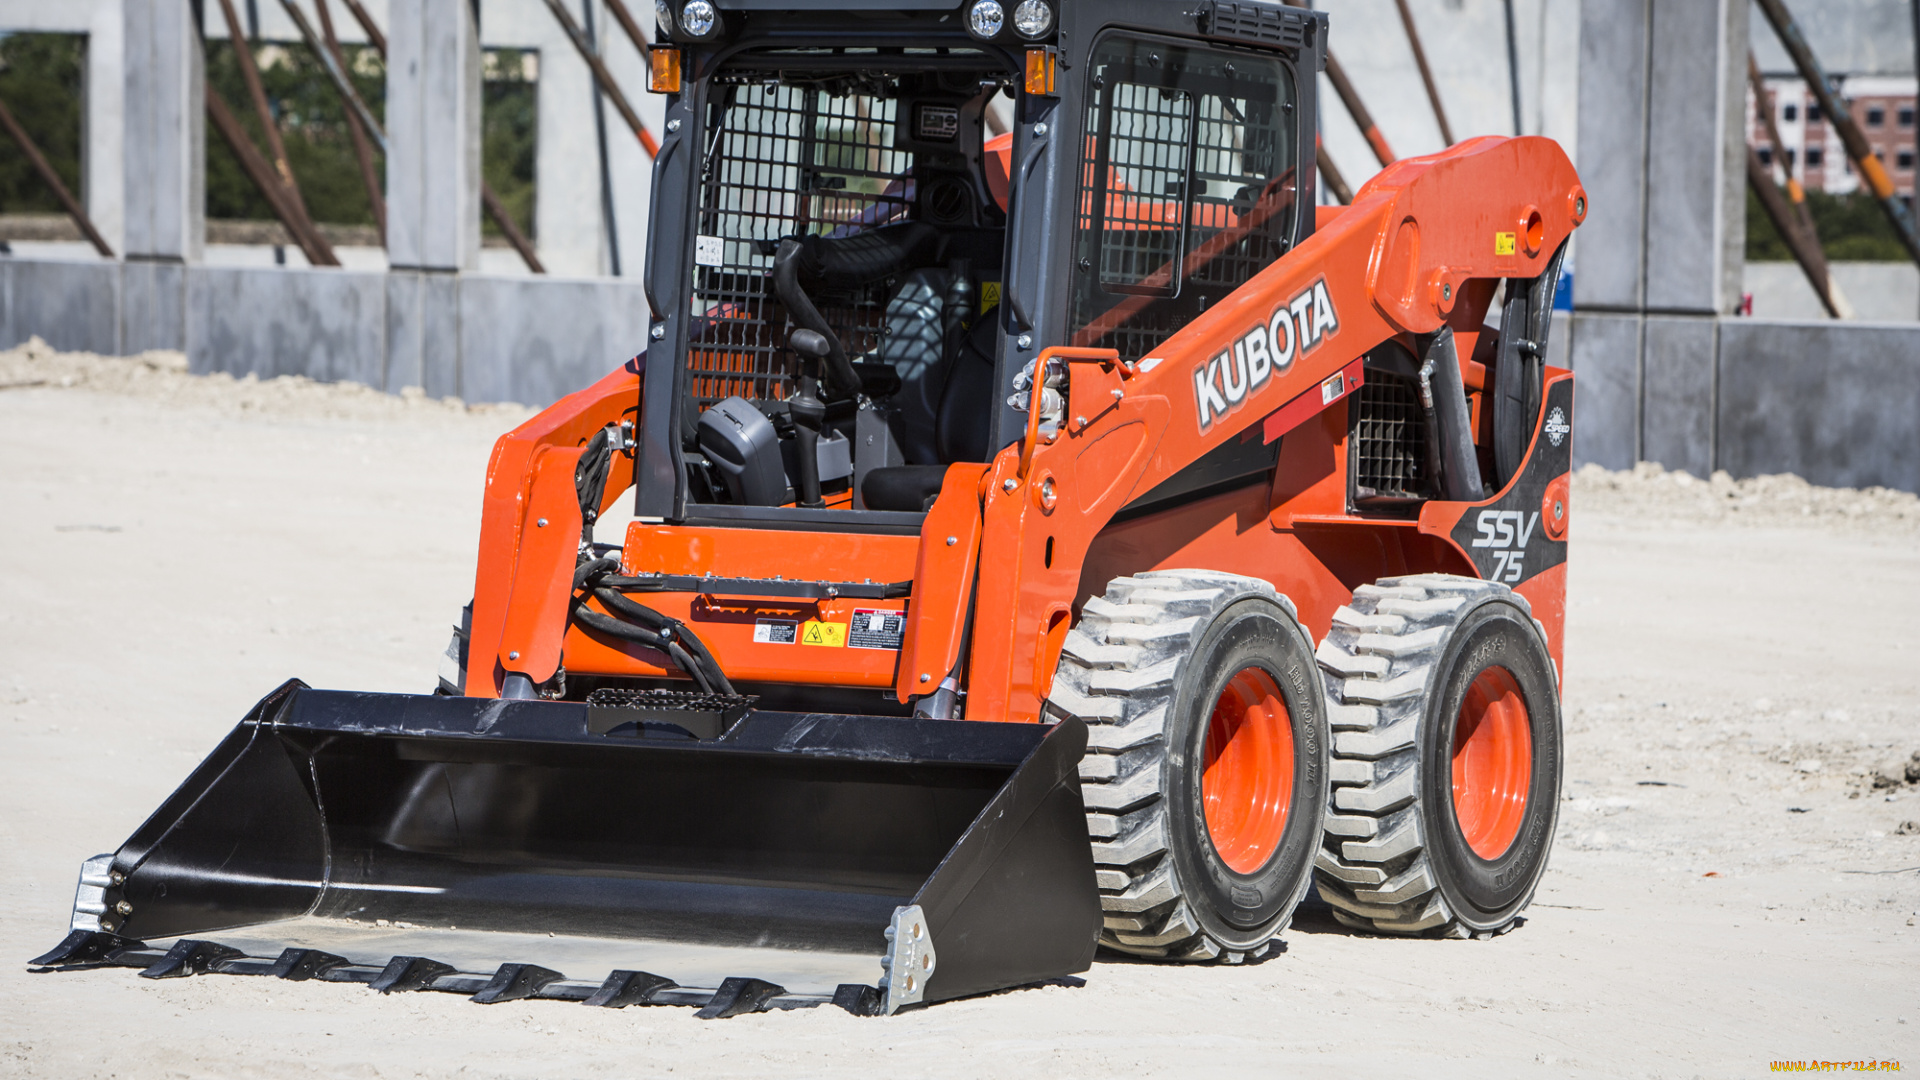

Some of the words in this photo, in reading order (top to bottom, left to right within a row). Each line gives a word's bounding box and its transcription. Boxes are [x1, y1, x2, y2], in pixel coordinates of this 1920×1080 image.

[1194, 280, 1338, 427] KUBOTA
[1472, 510, 1539, 548] SSV
[1491, 551, 1525, 582] 75
